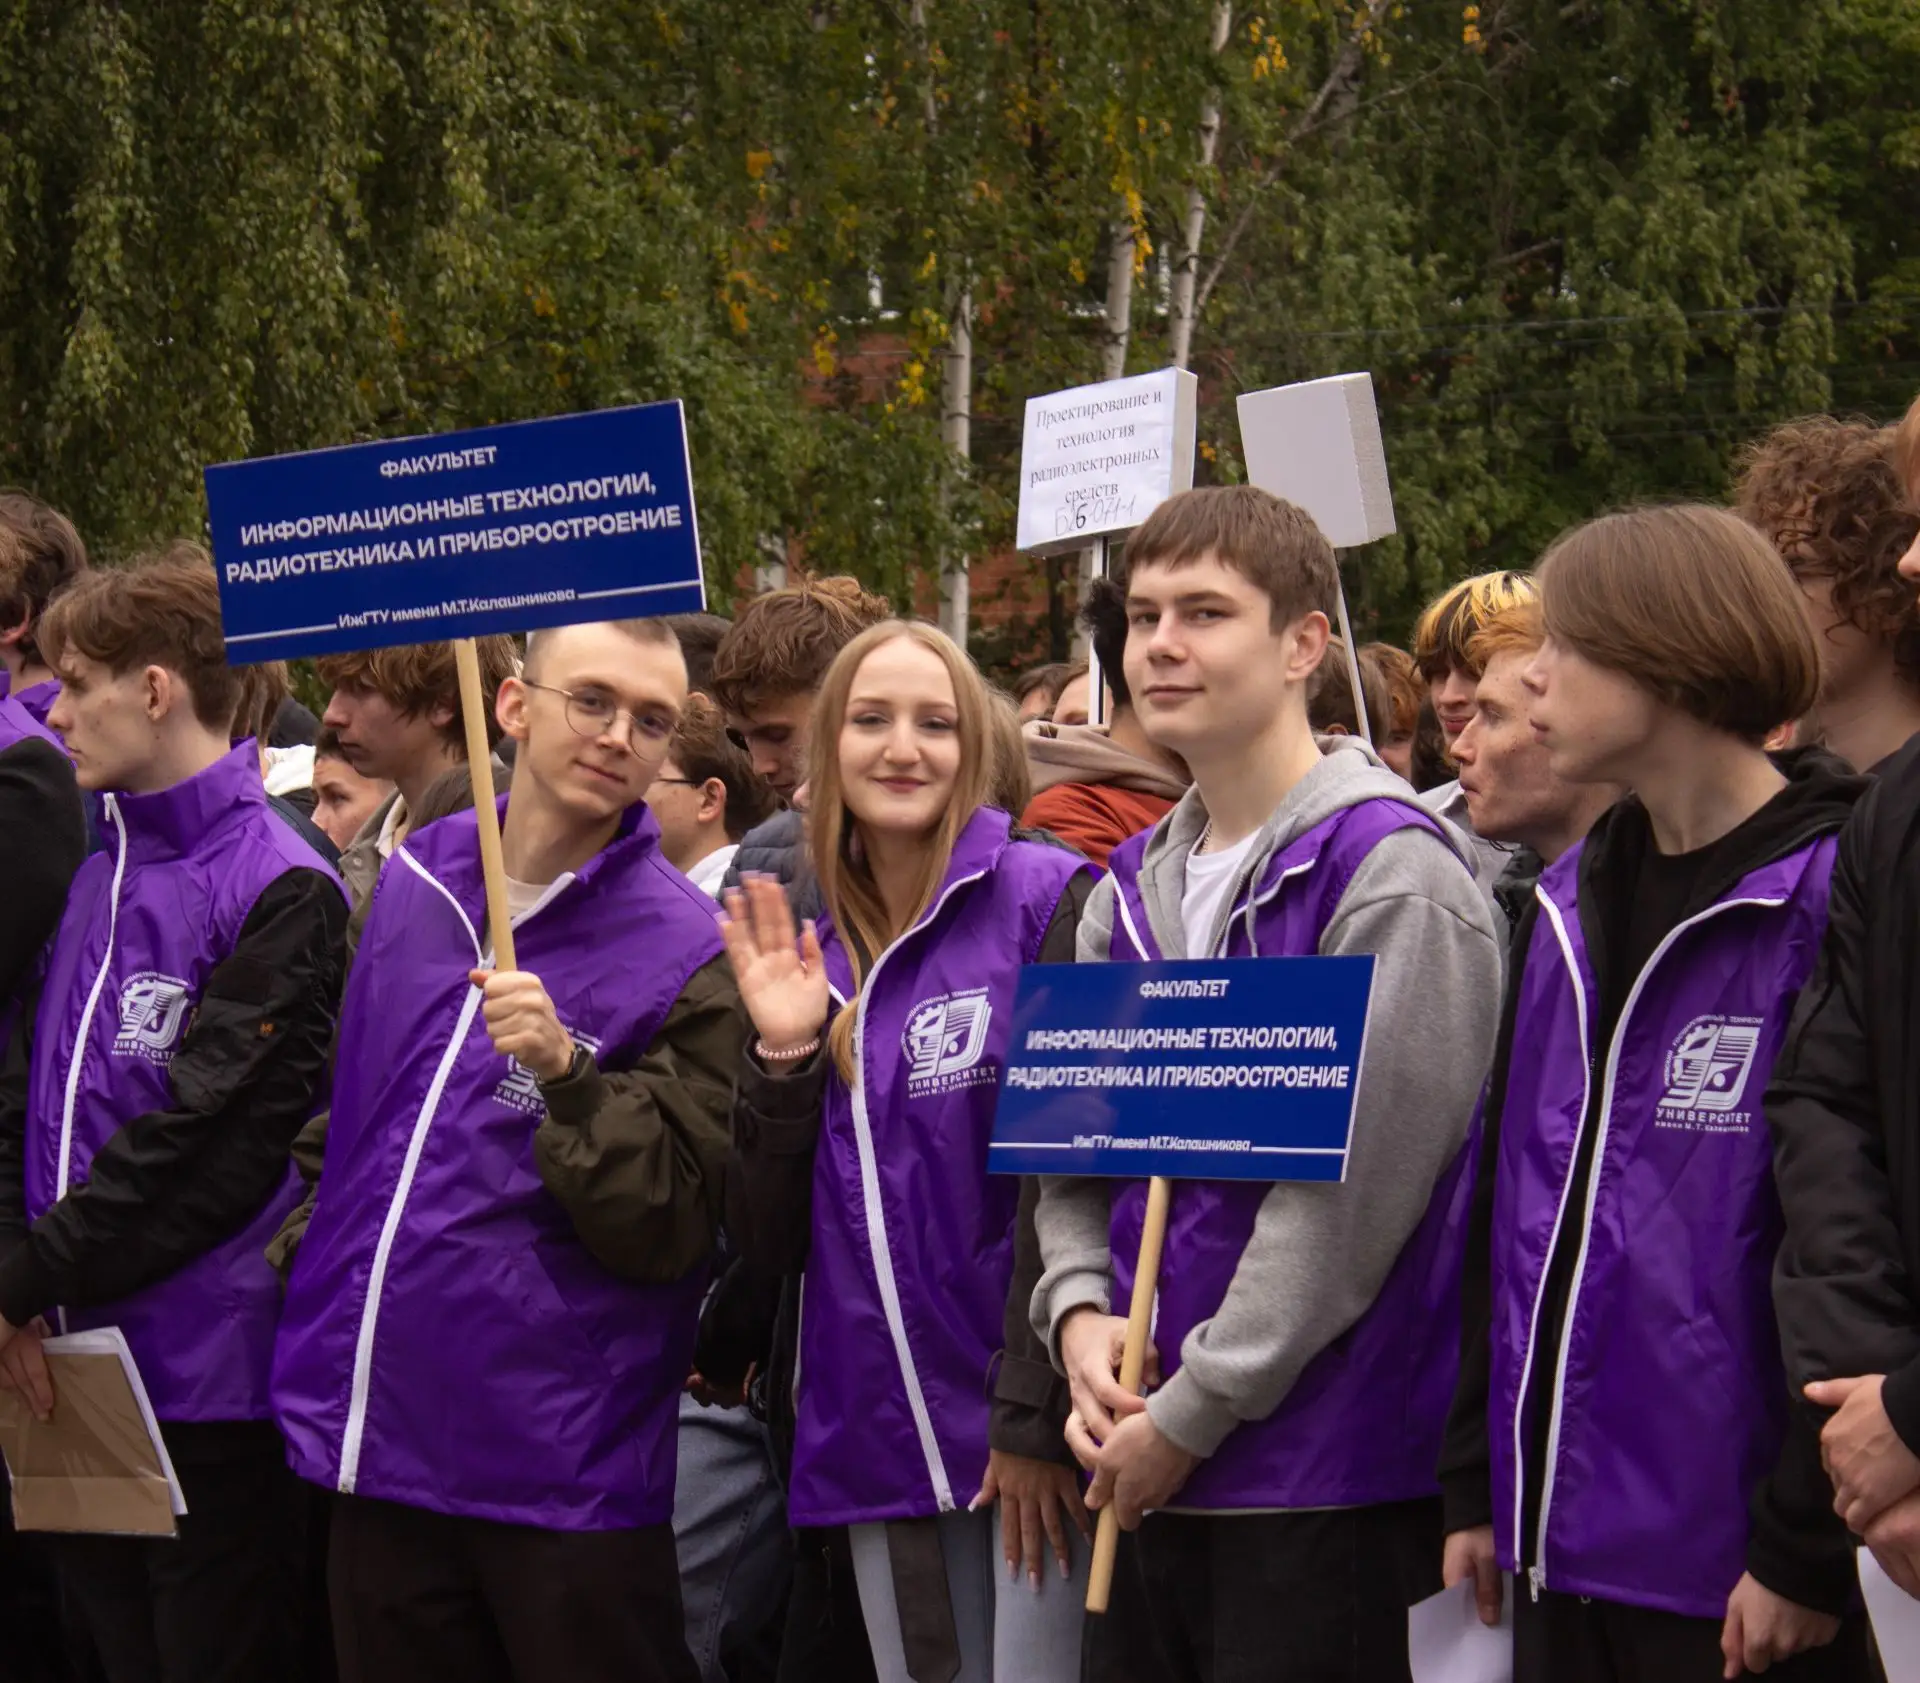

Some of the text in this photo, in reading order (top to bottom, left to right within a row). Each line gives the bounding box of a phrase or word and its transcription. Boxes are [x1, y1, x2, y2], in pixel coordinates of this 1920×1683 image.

[1036, 391, 1161, 428] Проектирование и
[1056, 424, 1135, 449] технология
[380, 446, 497, 478] ФАКУЛЬТЕТ
[1030, 447, 1160, 488] радиоэлектронных
[1065, 483, 1118, 508] средств
[241, 471, 657, 547] ИНФОРМАЦИОННЫЕ ТЕХНОЛОГИИ,
[226, 505, 682, 583] РАДИОТЕХНИКА И ПРИБОРОСТРОЕНИЕ
[338, 588, 576, 629] ИжГТУ имени М.Т.Калашникова
[1139, 979, 1230, 998] ФАКУЛЬТЕТ
[1026, 1026, 1338, 1052] ИНФОРМАЦИОННЫЕ ТЕХНОЛОГИИ,
[908, 1066, 996, 1092] УНИВЕРСИТЕТ
[1006, 1065, 1350, 1090] РАДИОТЕХНИКА И ПРИБОРОСТРОЕНИЕ
[1073, 1135, 1251, 1152] ИжГТУ имени М.Т.Калашникова
